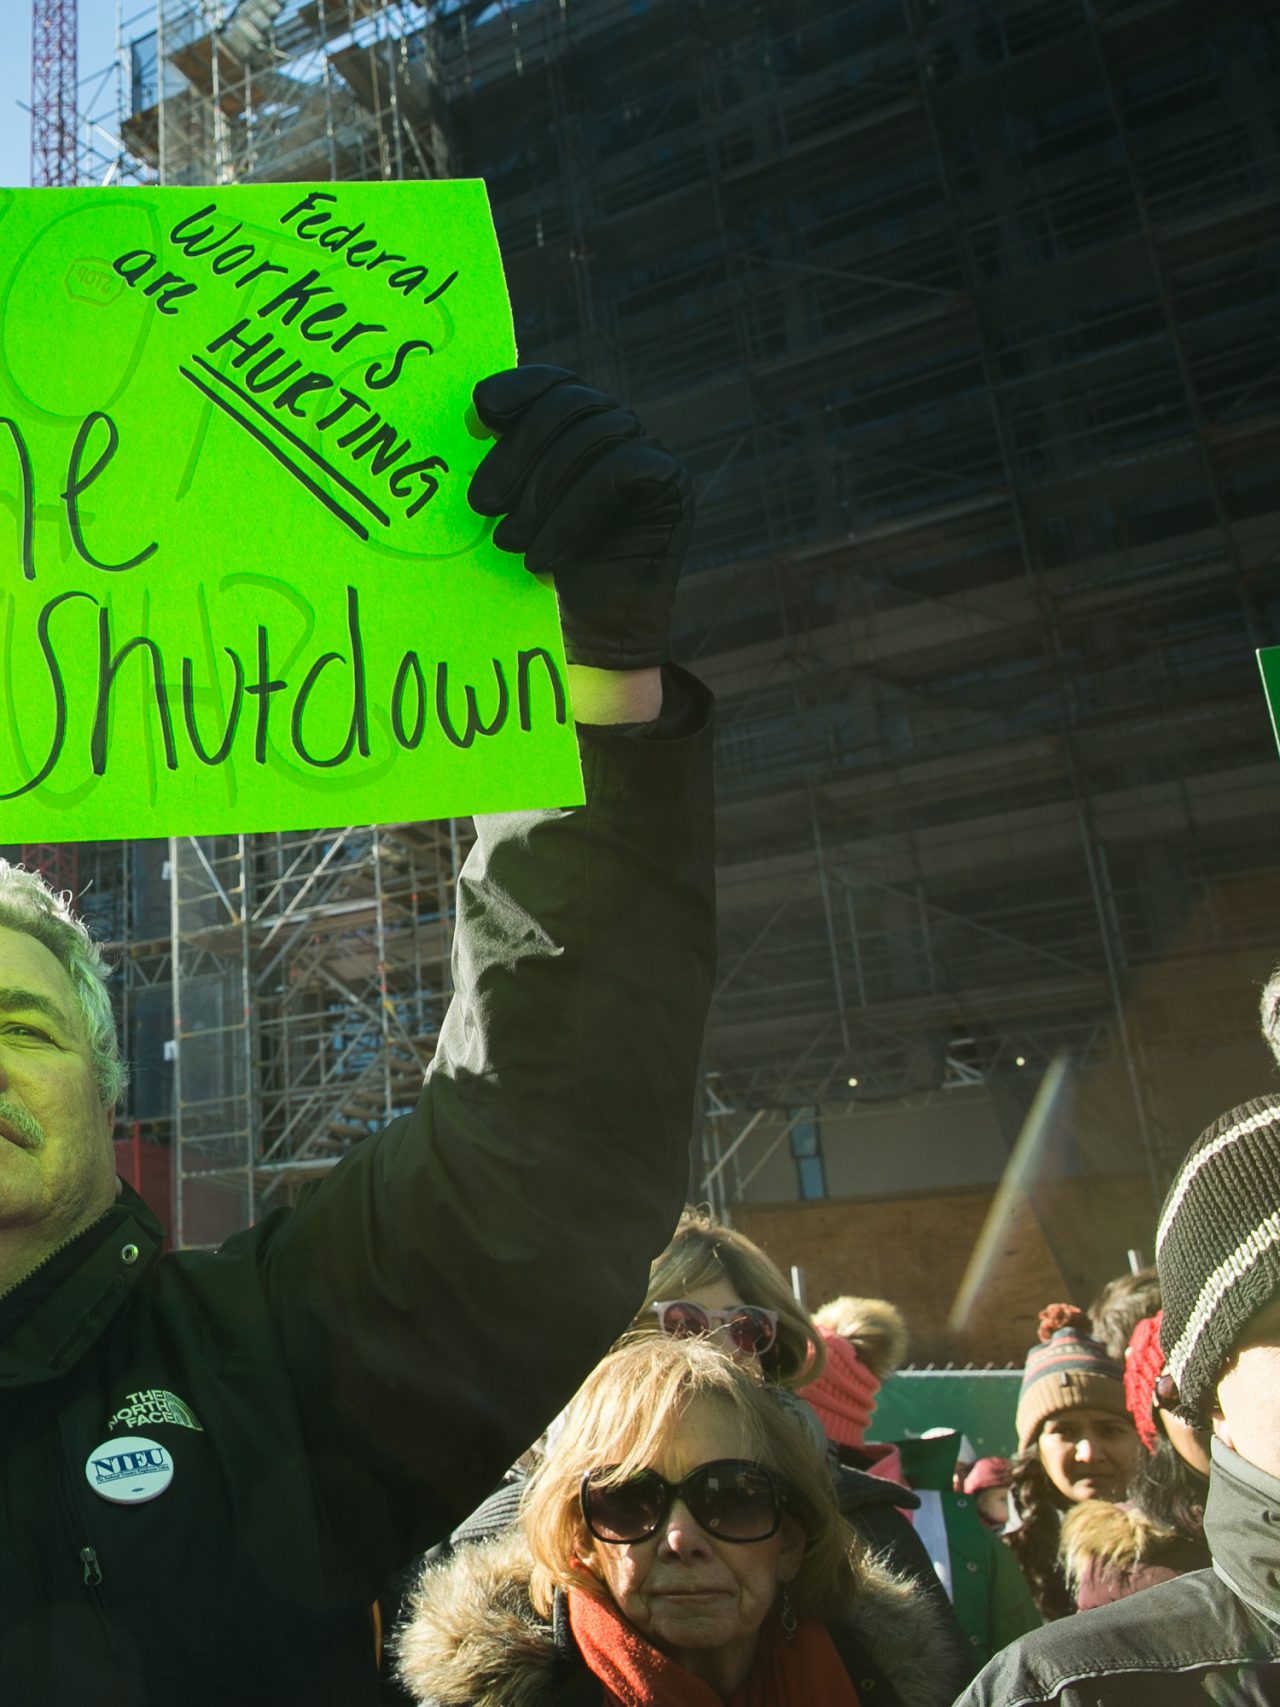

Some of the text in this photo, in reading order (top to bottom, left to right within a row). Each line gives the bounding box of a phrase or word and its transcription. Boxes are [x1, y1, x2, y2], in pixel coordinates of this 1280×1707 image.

[279, 191, 459, 305] Federal
[111, 249, 450, 518] are HURTING
[126, 1389, 164, 1404] THE
[108, 1401, 170, 1431] NORTH
[126, 1412, 177, 1429] FACE
[92, 1448, 165, 1477] NTEU
